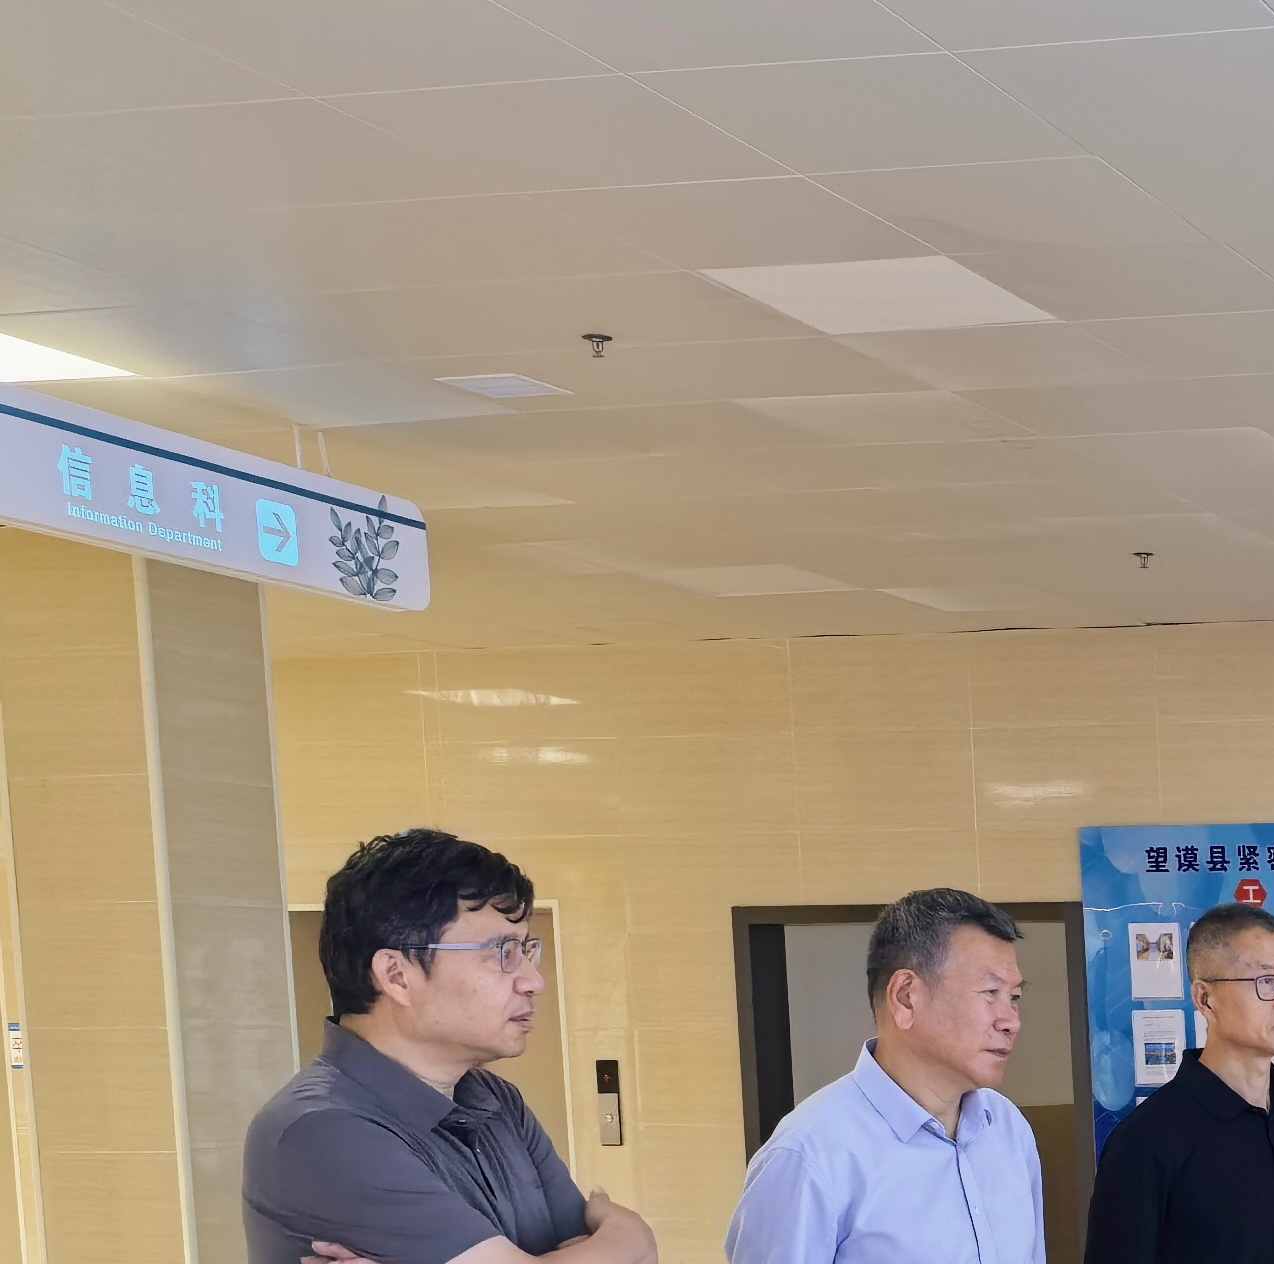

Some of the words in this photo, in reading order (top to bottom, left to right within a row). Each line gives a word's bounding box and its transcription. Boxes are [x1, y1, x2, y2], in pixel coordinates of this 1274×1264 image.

[57, 443, 224, 533] 信息科
[67, 502, 143, 535] Information
[148, 522, 223, 552] Department
